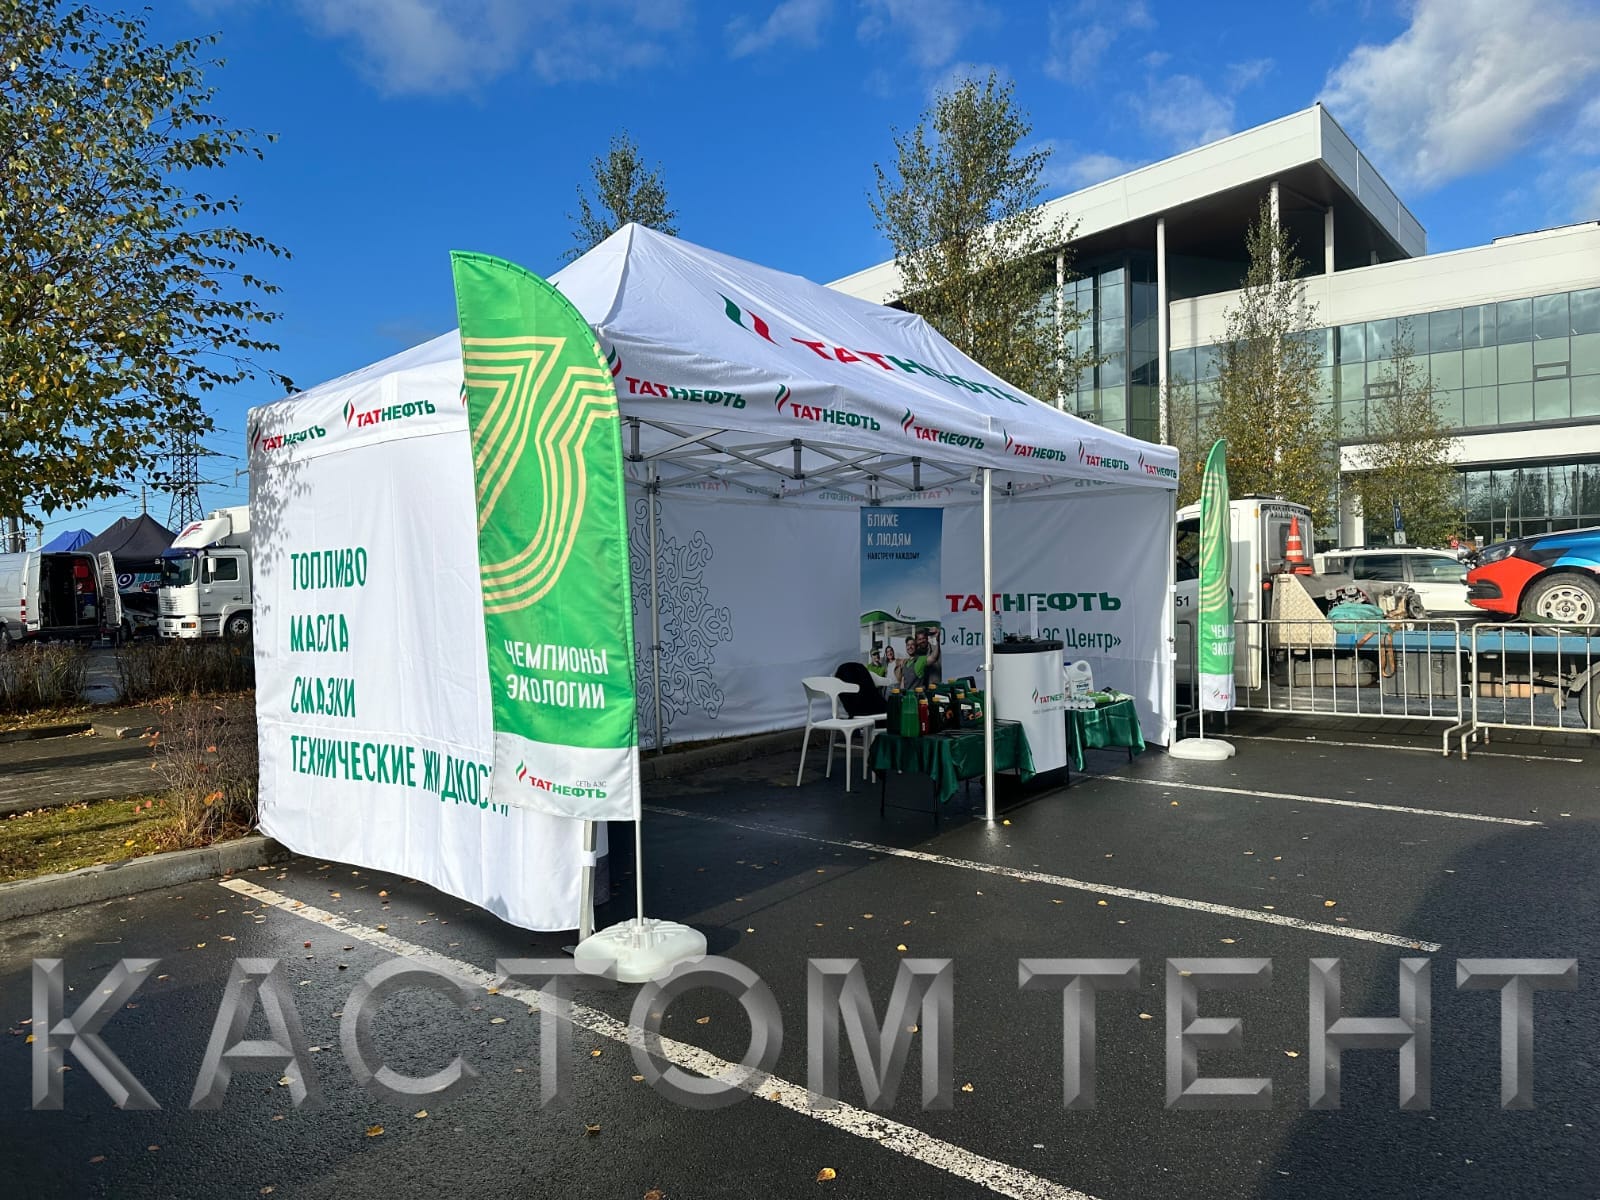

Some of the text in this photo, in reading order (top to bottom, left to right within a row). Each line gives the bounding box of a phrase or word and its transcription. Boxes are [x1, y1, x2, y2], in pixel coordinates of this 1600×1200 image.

[626, 377, 746, 409] ТАТНЕФТЬ
[356, 399, 436, 427] ТАТНЕФТЬ
[790, 403, 880, 431] ТАТНЕФТЬ
[262, 424, 326, 451] ТАТНЕФТЬ
[914, 426, 984, 450] ТАТНЕФТЬ
[1014, 444, 1066, 462] ТАТНЕФТЬ
[1086, 455, 1129, 471] ТАТНЕФТЬ
[1145, 464, 1177, 479] ТАТНЕФТЬ
[867, 513, 899, 527] БЛИЖЕ
[867, 533, 912, 547] К ЛЮДЯМ
[291, 547, 367, 590] ТОПЛИВО
[1176, 596, 1190, 607] 51
[291, 614, 349, 652] МАСЛА
[1066, 628, 1121, 652] Центр»
[504, 639, 609, 675] ЧЕМПИОНЫ
[291, 676, 356, 718] СМАЗКИ
[506, 674, 606, 709] ЭКОЛОГИИ
[290, 735, 508, 817] ТЕХНИЧЕСКИЕ ЖИДКОС
[529, 776, 607, 798] ТАТНЕФТЬ
